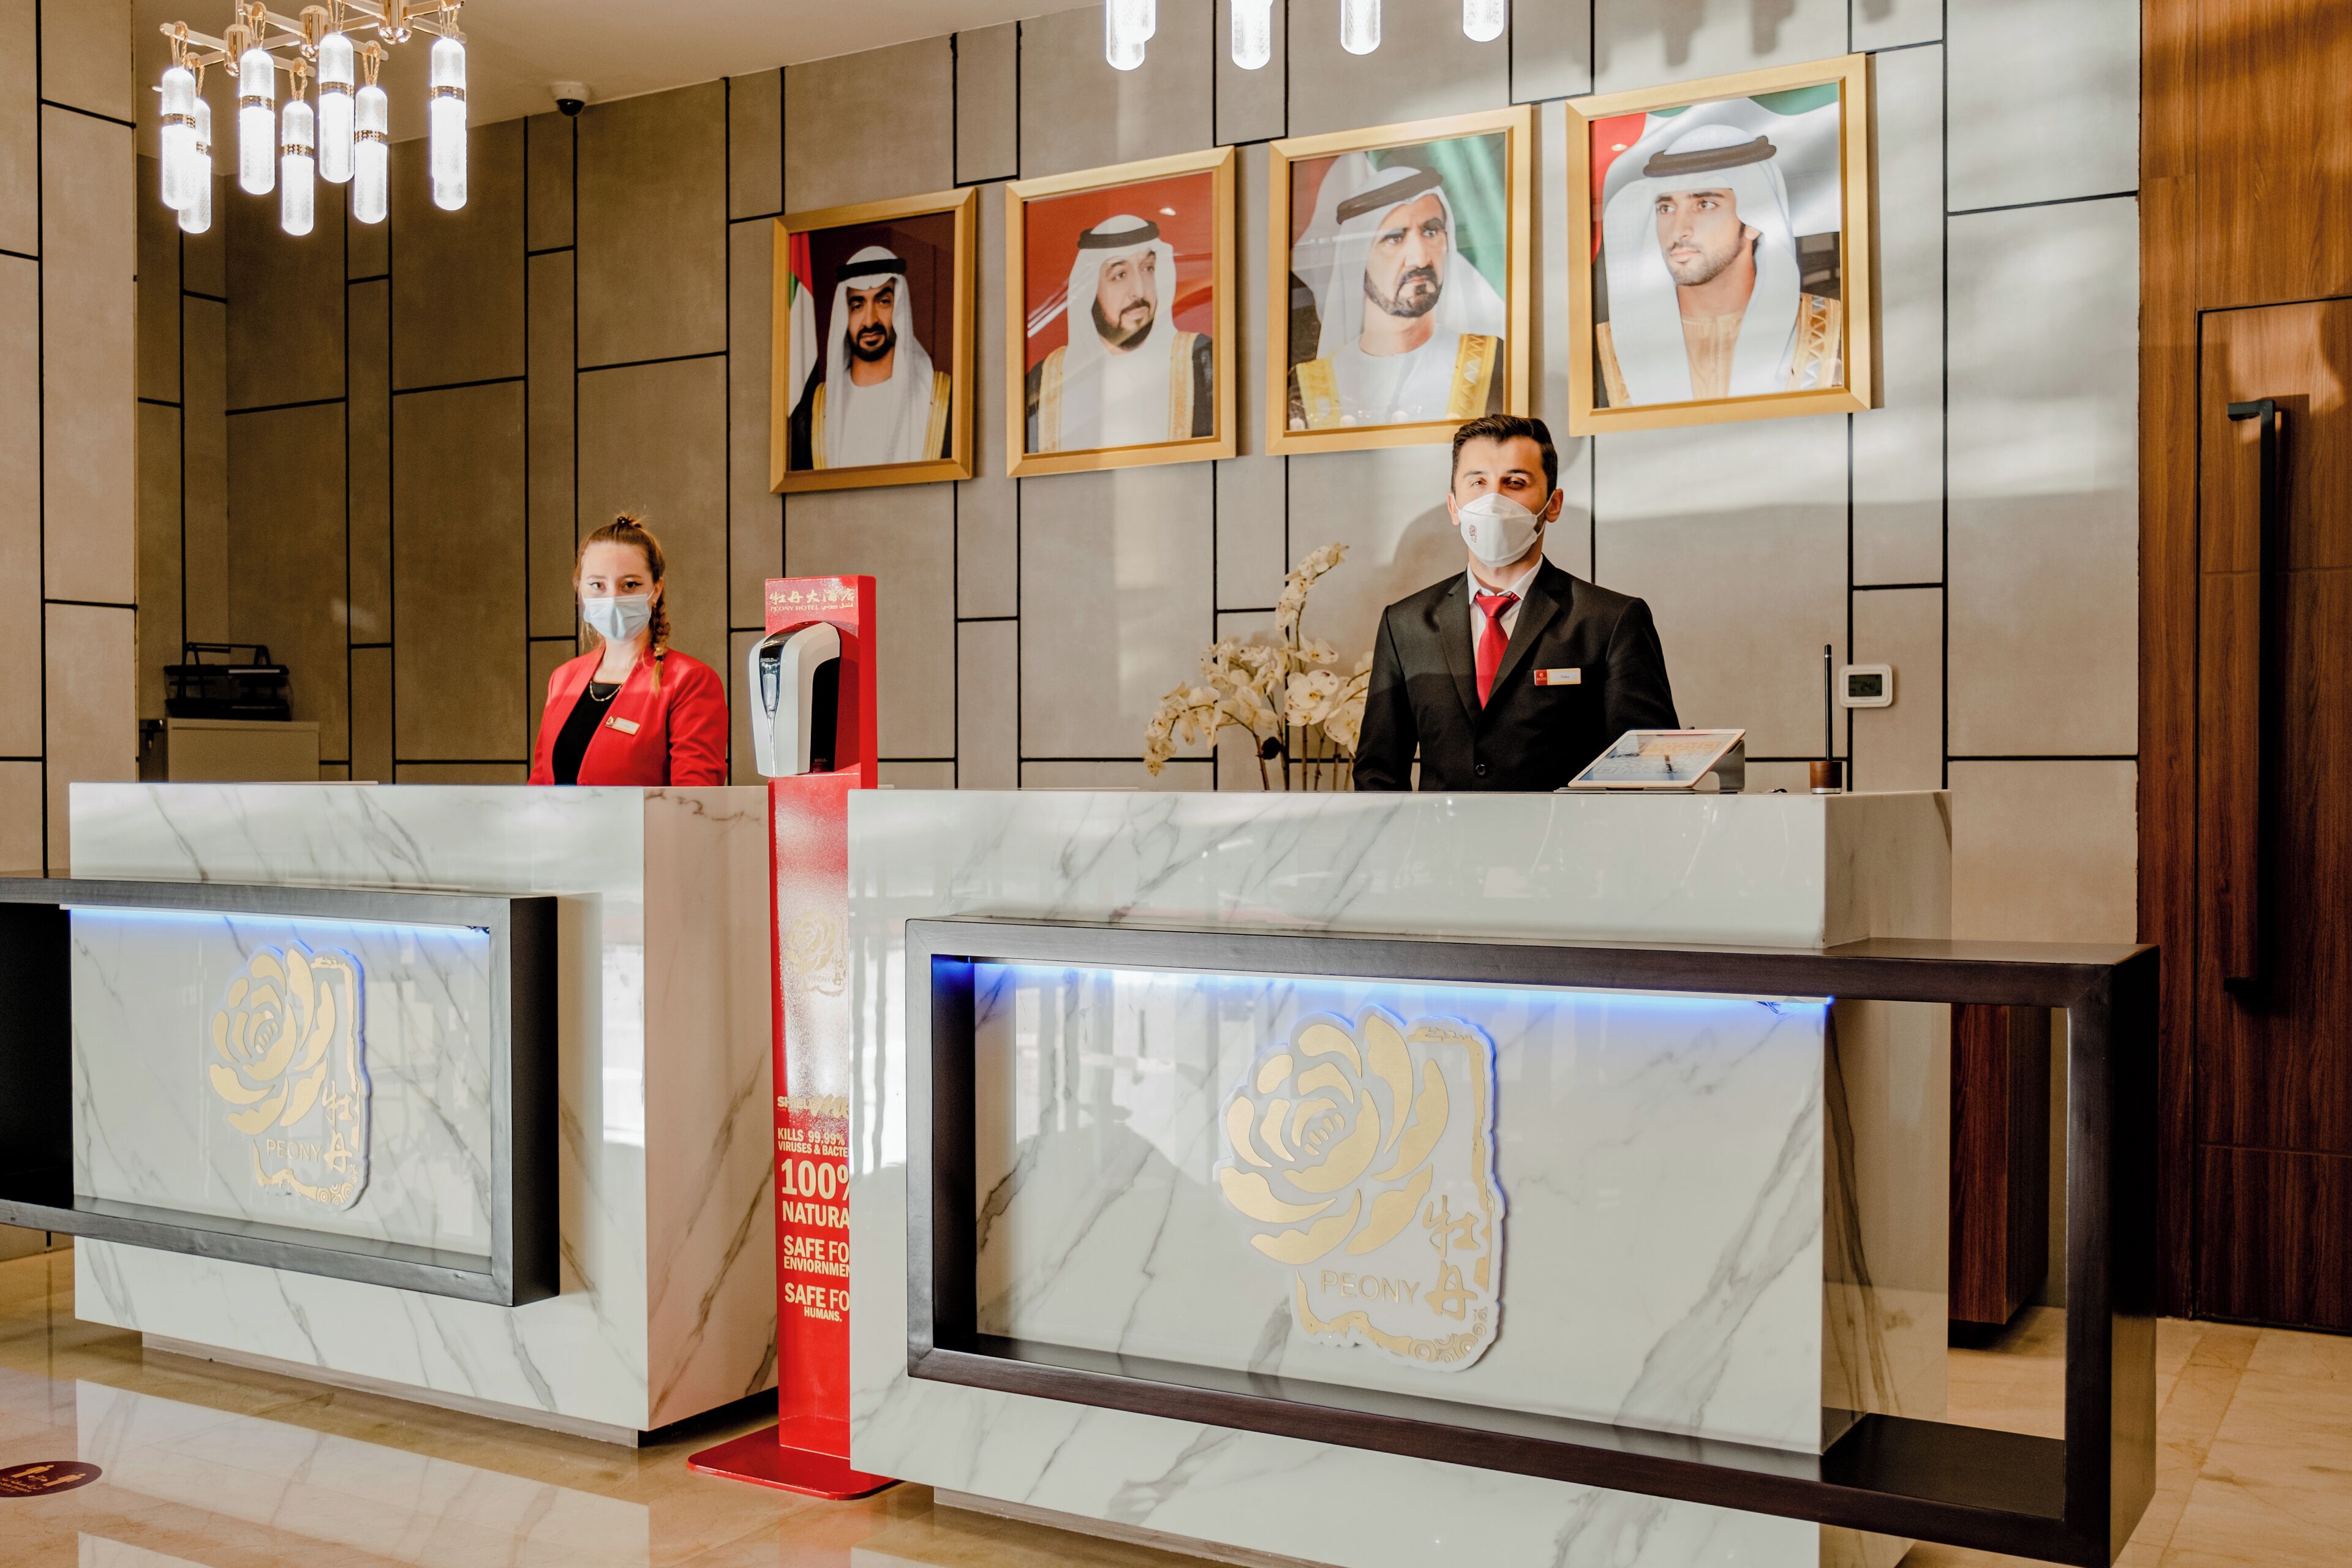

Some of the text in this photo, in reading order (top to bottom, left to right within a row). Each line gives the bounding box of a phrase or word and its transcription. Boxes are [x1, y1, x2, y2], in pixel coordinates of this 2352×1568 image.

[266, 1138, 323, 1163] PEONY
[777, 1128, 846, 1147] KILLS 99.99%
[777, 1140, 813, 1155] VIRUSES
[813, 1144, 821, 1155] &
[782, 1200, 850, 1230] NATURA
[783, 1234, 850, 1264] SAFE FO
[1422, 1194, 1481, 1321] 牡丹
[784, 1282, 850, 1312] SAFE FO
[1320, 1269, 1421, 1305] PEONY
[804, 1306, 843, 1322] HUMANS.
